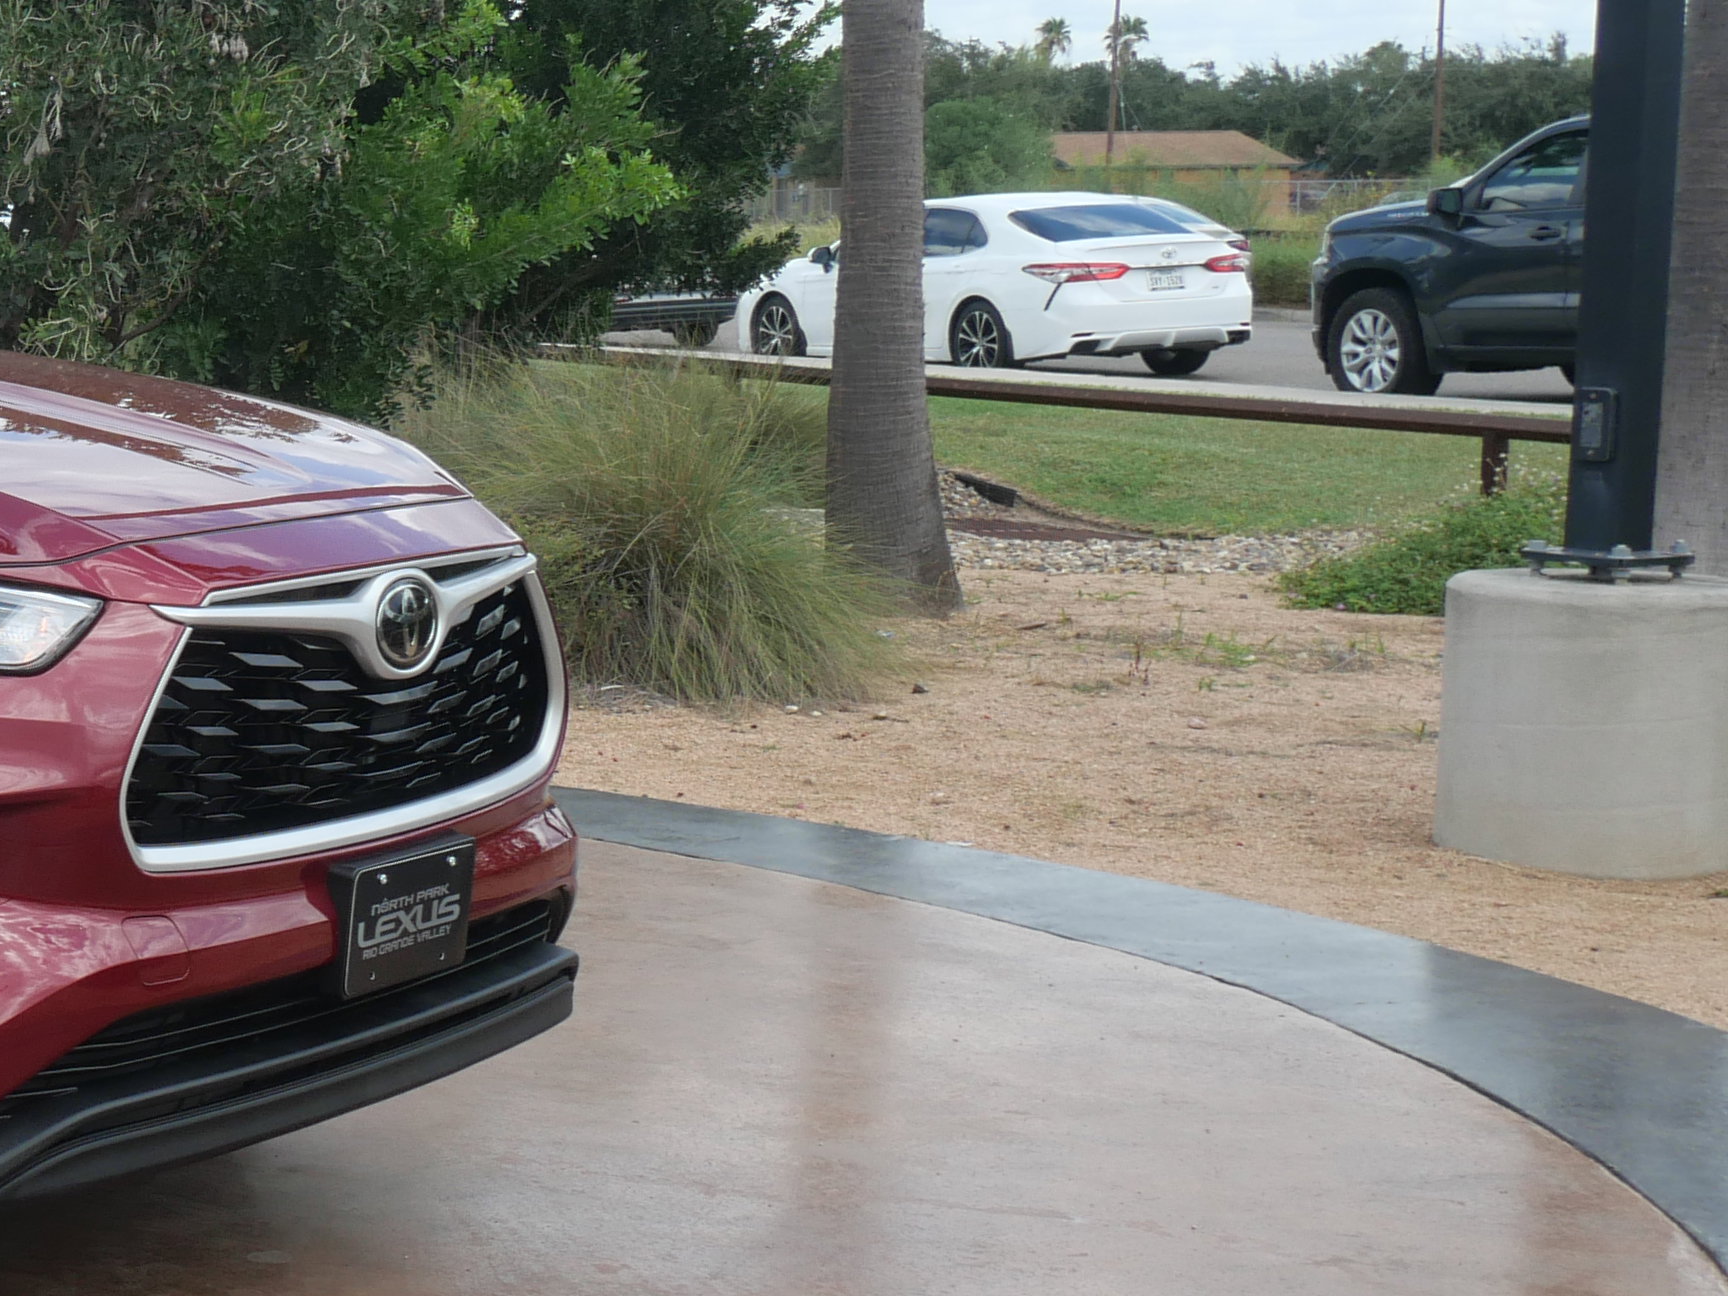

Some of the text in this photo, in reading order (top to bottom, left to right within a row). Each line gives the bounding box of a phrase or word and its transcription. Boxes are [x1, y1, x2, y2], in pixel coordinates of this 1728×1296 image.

[371, 883, 450, 916] NORTH PARK
[357, 893, 461, 948] LEXUS
[363, 923, 452, 960] RIO GRANDE VALLEY
